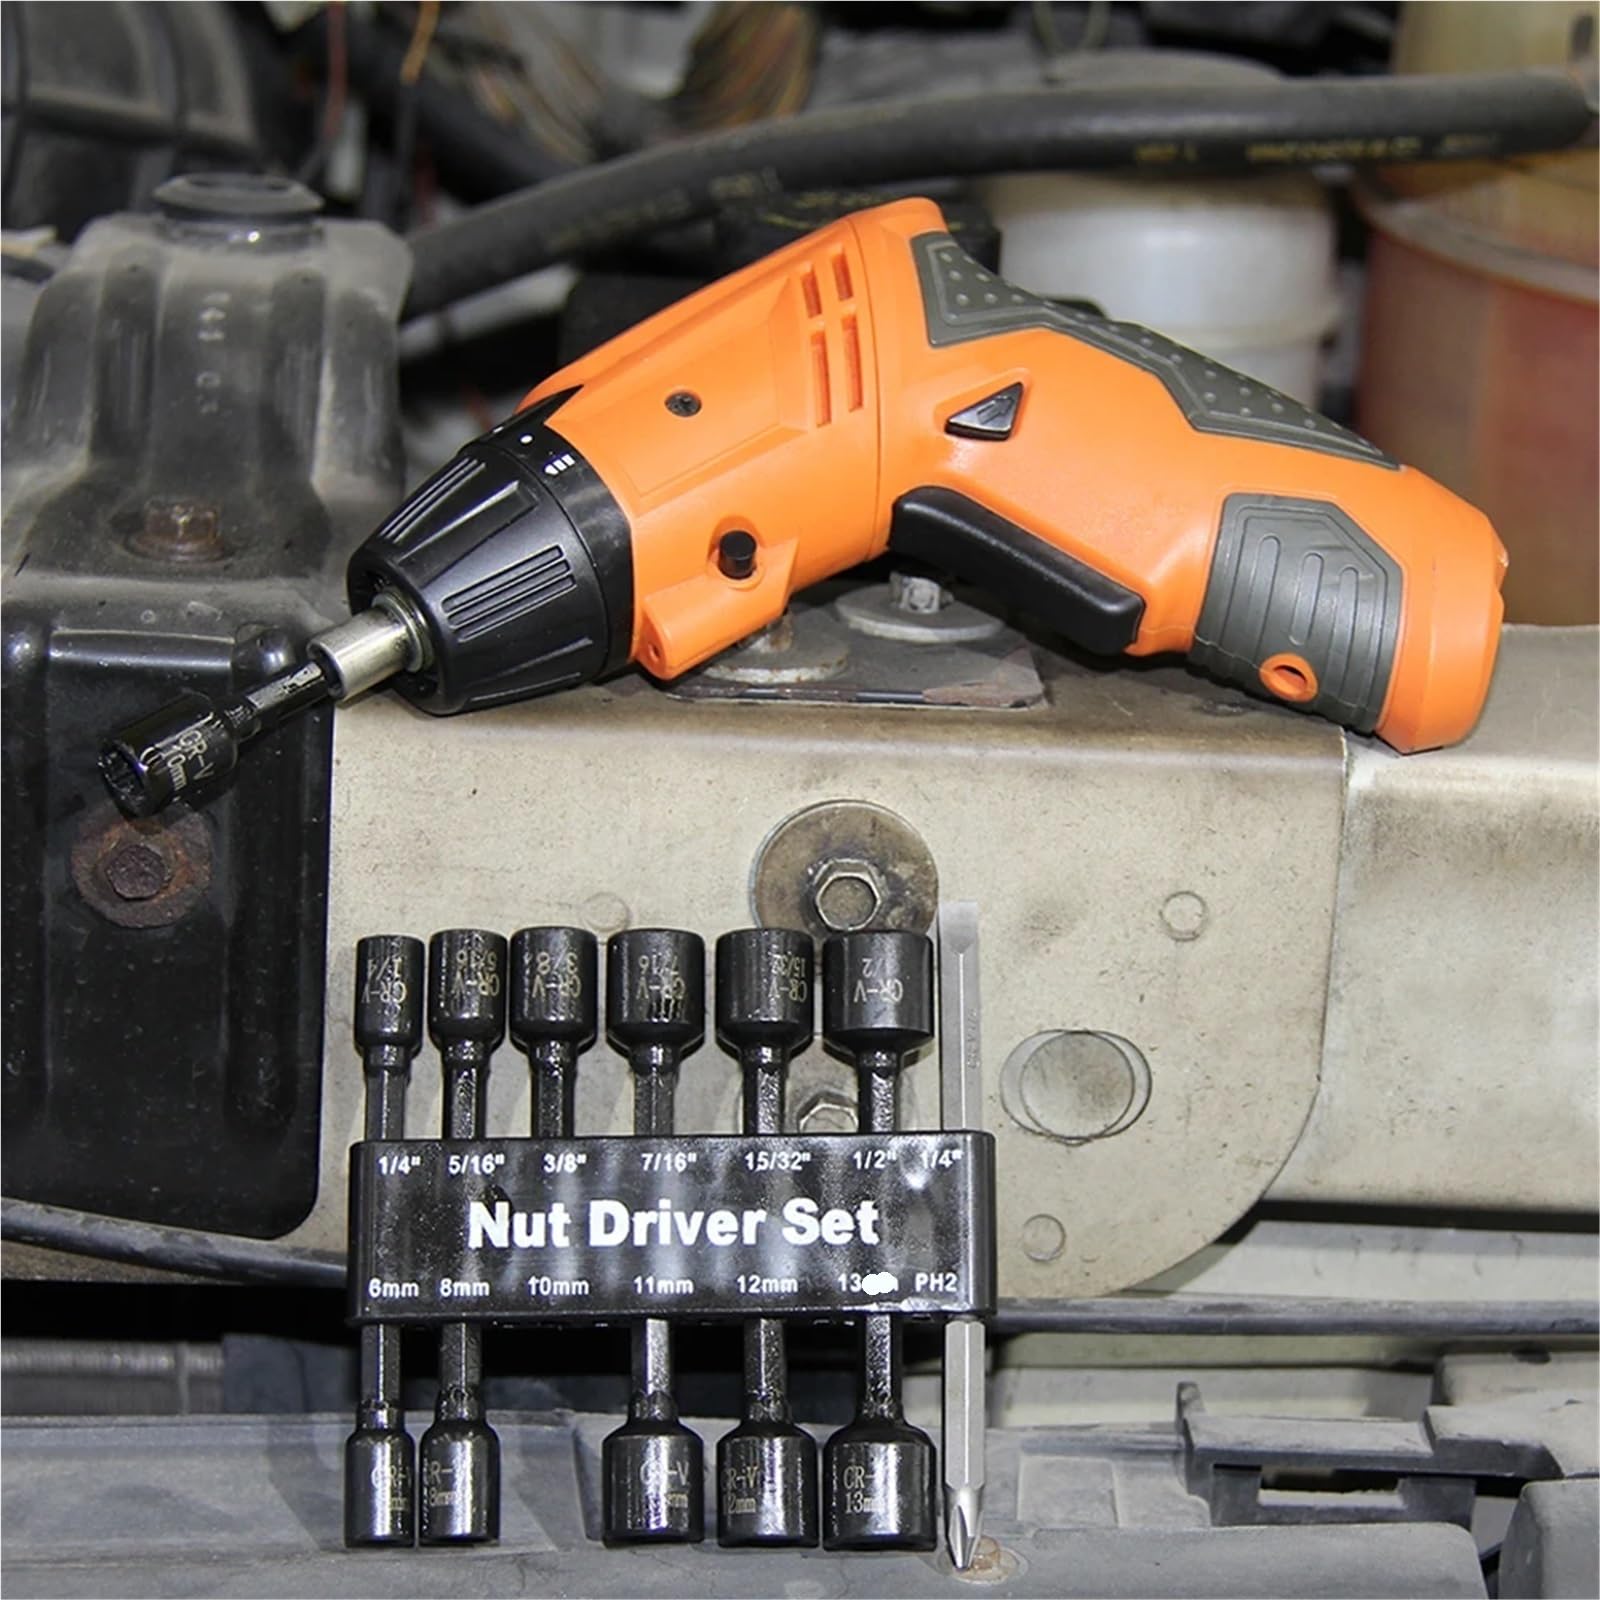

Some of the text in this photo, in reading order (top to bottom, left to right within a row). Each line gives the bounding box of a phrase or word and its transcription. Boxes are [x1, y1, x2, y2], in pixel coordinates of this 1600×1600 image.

[536, 951, 578, 975] 3/8
[532, 974, 582, 998] CR-V
[378, 1149, 963, 1175] 1/4" 5/16" 3/8" 7/16" 15/32" 1/2" 1/4"
[468, 1196, 880, 1249] Nut Driver Set
[368, 1272, 957, 1298] 6mm 8mm 10mm 11mm 12mm 13 PH2
